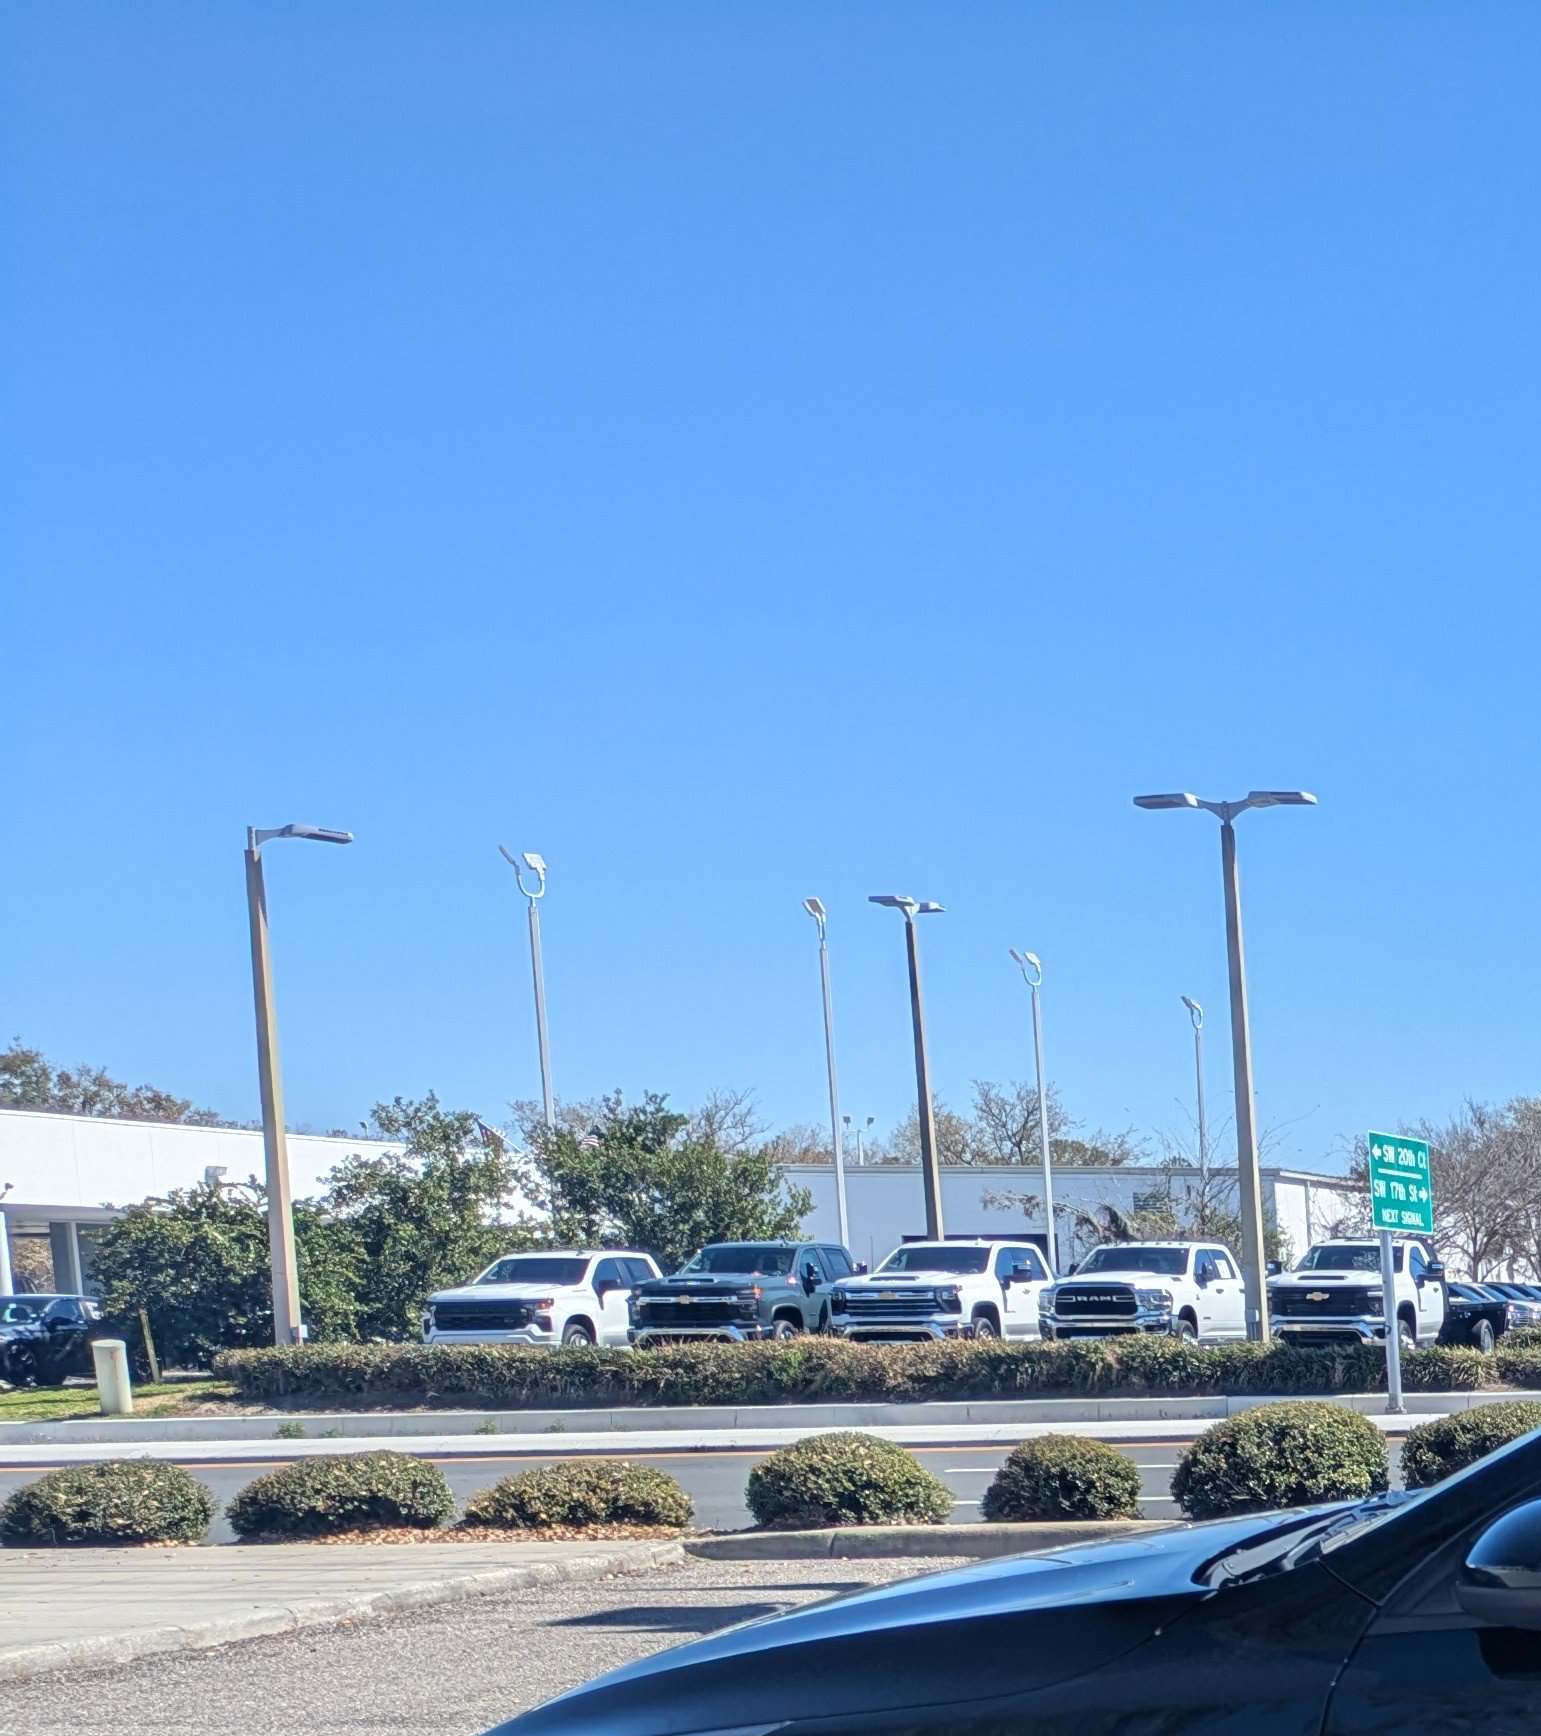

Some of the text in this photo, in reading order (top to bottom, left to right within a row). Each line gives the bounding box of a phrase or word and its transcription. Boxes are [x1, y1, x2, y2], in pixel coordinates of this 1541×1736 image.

[1382, 1144, 1427, 1169] SW 20th Ct
[1373, 1179, 1418, 1203] SW 17th St
[1382, 1208, 1425, 1227] NEXT SIGNAL
